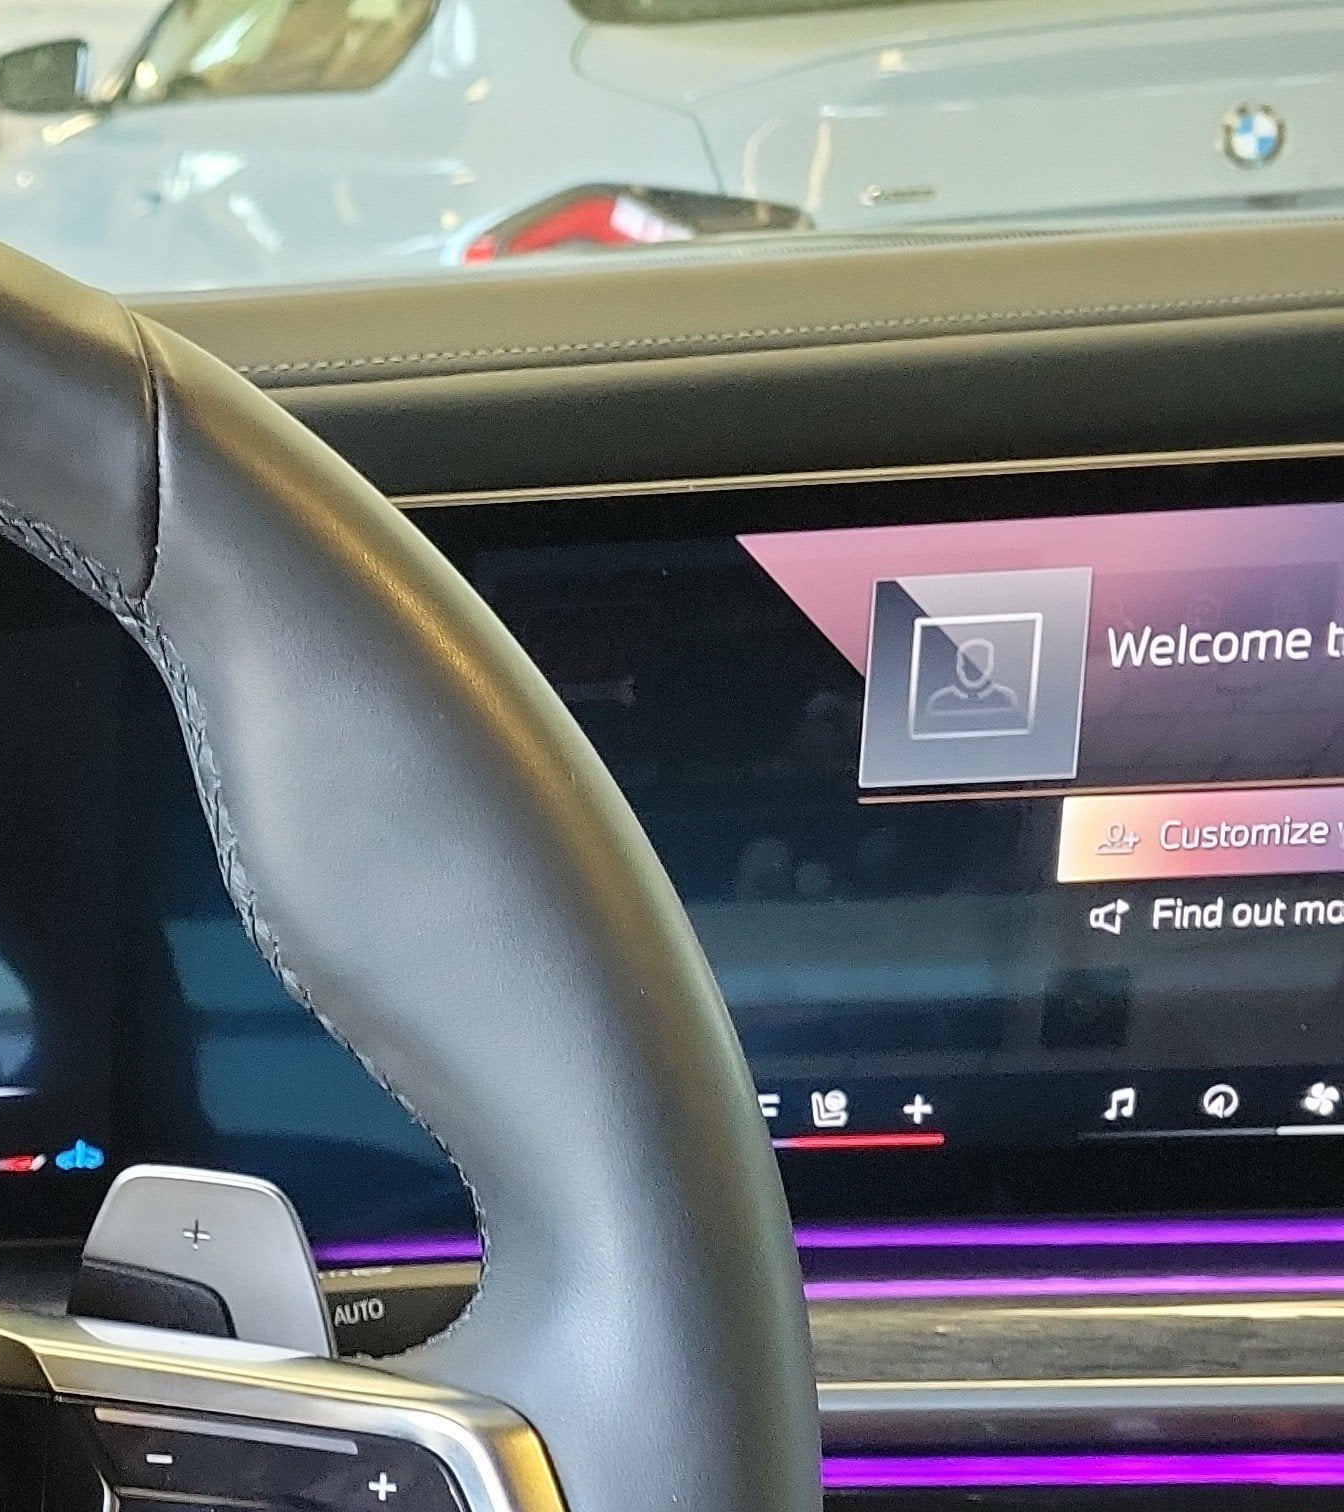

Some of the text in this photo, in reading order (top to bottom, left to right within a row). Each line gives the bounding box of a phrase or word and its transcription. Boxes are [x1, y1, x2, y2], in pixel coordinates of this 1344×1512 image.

[1107, 621, 1344, 669] Welcome t
[1160, 815, 1330, 851] Customize
[1152, 896, 1224, 931] Find
[1232, 897, 1287, 928] out
[334, 1298, 385, 1328] AUTO
